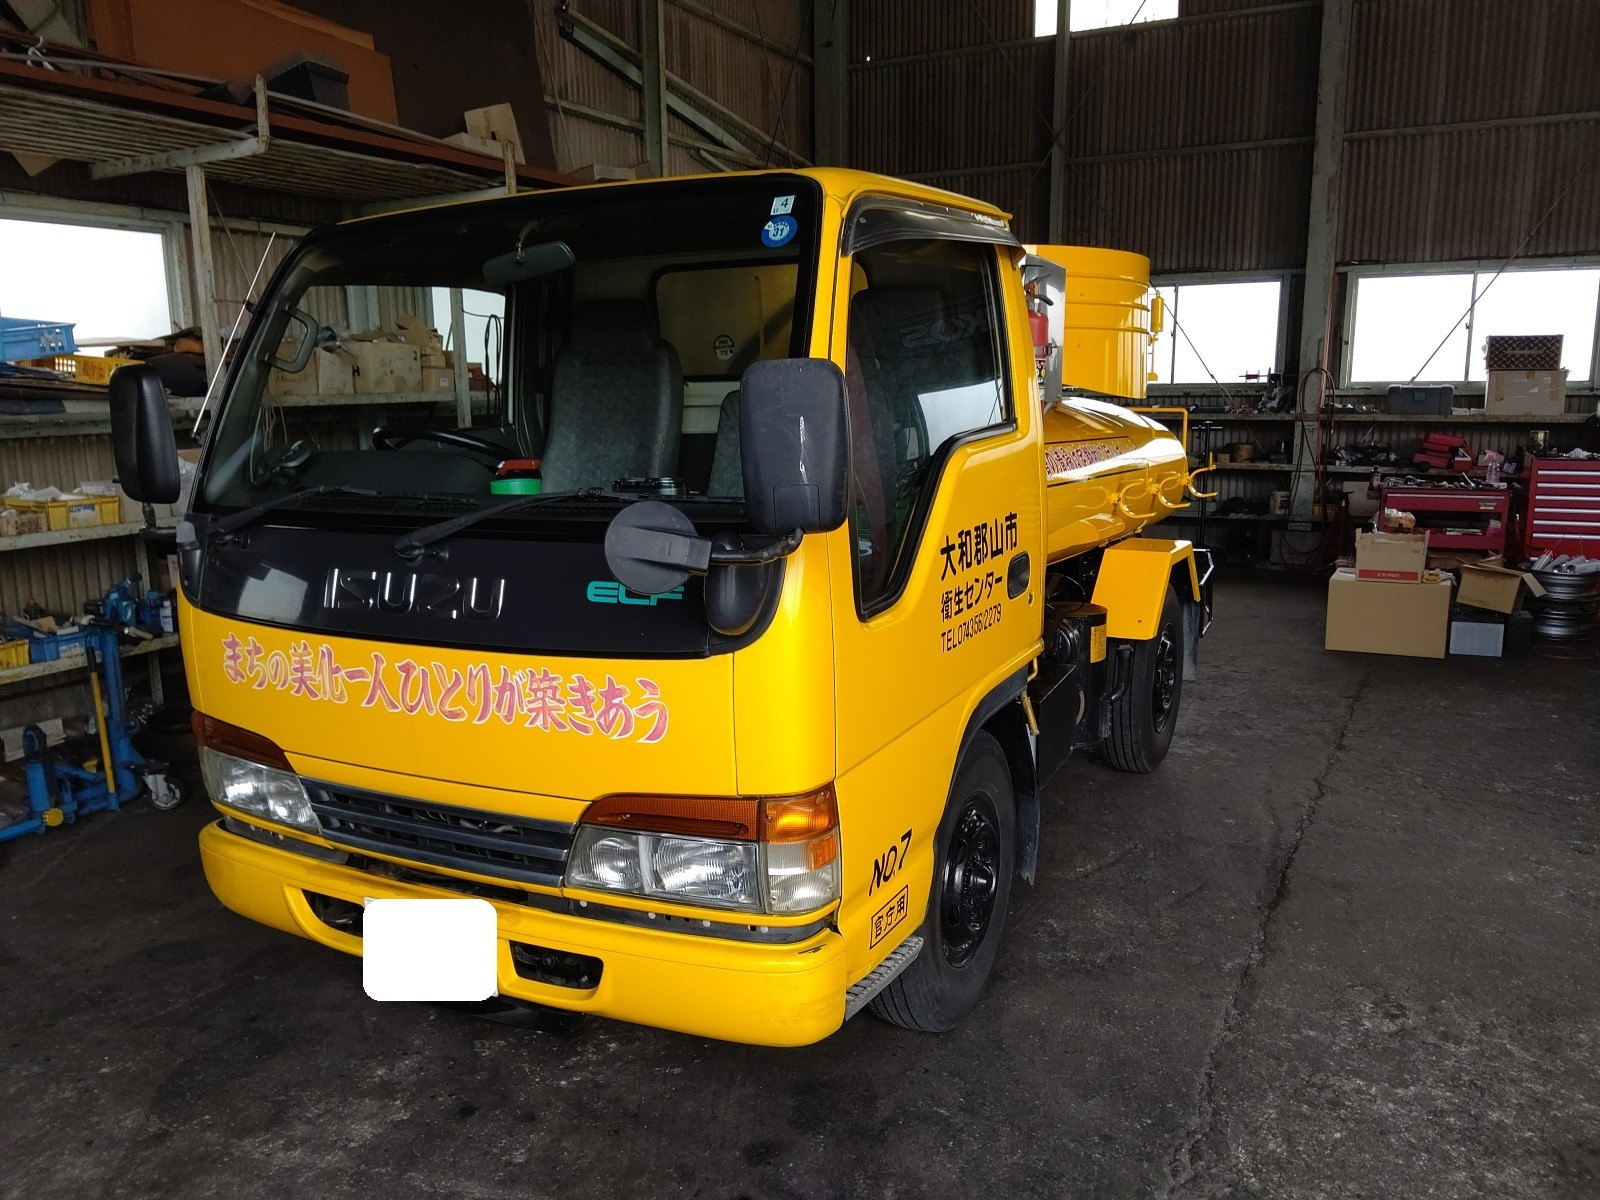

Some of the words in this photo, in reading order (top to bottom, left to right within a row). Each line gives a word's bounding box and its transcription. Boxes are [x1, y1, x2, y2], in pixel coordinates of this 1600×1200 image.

[772, 227, 785, 238] 31
[940, 511, 1018, 582] 大和郡山市
[323, 568, 505, 621] ISUZU
[940, 571, 1003, 623] 衛生センター
[221, 632, 670, 744] まちの美化一人ひとりが築きあう
[874, 893, 906, 940] 官庁用
